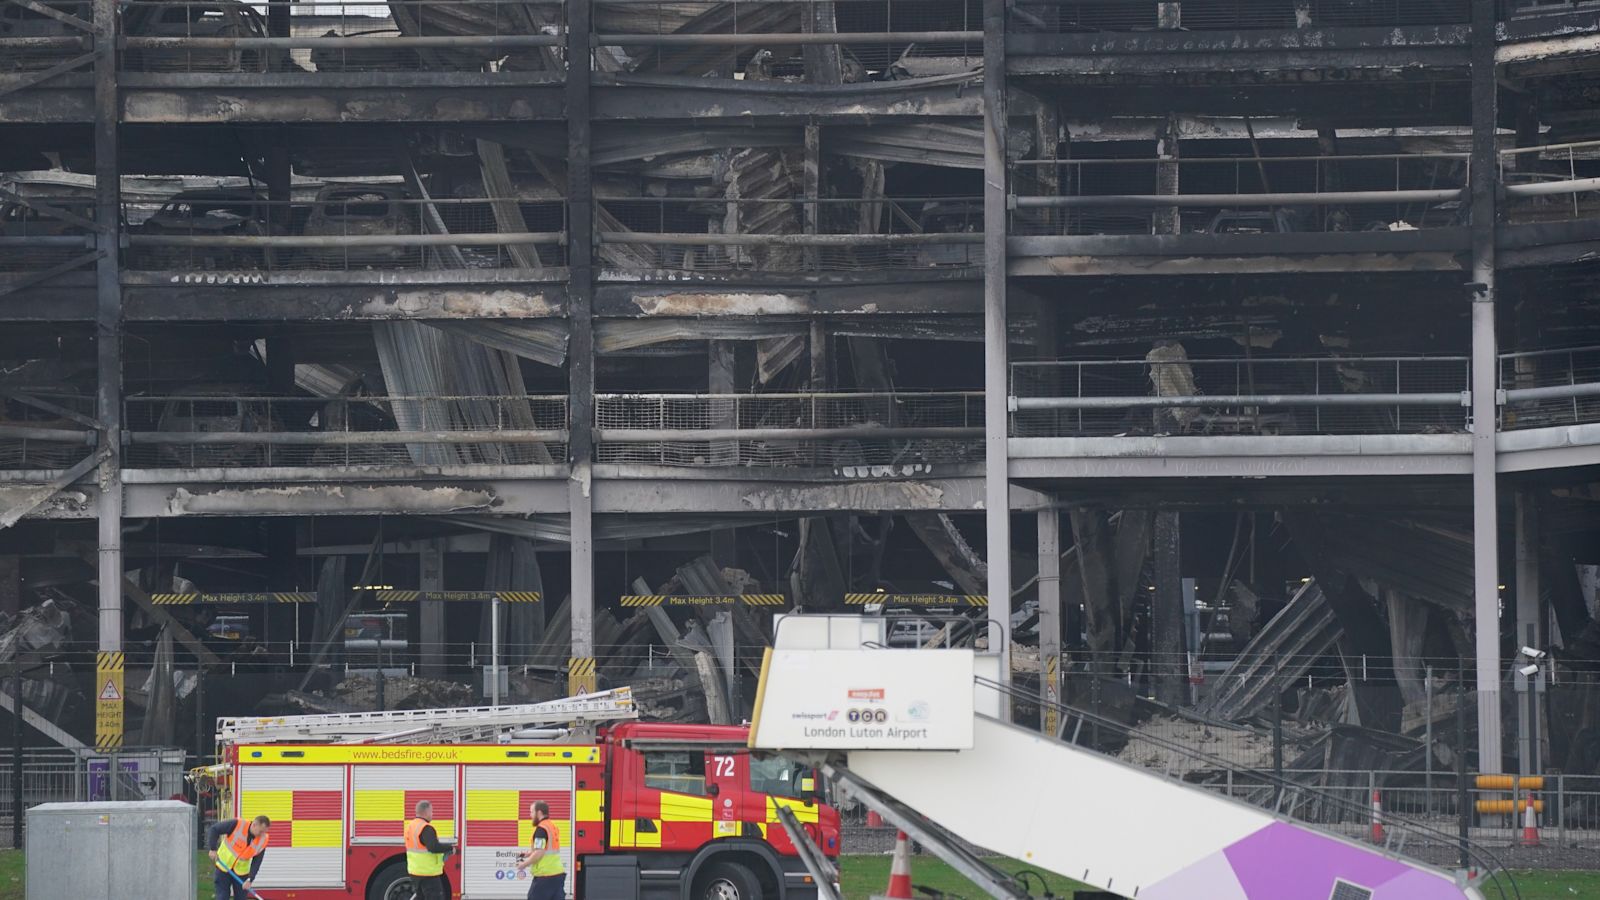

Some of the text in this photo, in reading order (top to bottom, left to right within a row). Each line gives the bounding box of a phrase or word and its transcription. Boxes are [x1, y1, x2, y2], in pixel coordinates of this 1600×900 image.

[202, 594, 218, 602] Max
[220, 594, 245, 603] Height
[444, 592, 469, 601] Height
[670, 596, 735, 606] Max Height 3.4m
[893, 595, 958, 605] Max Height 3.4m
[97, 711, 122, 719] HEIGHT
[792, 712, 827, 720] swissport
[848, 709, 887, 723] TCR
[804, 727, 927, 740] London Luton Airport
[353, 749, 458, 760] www.bedsfire.gov.uk
[714, 756, 735, 777] 72
